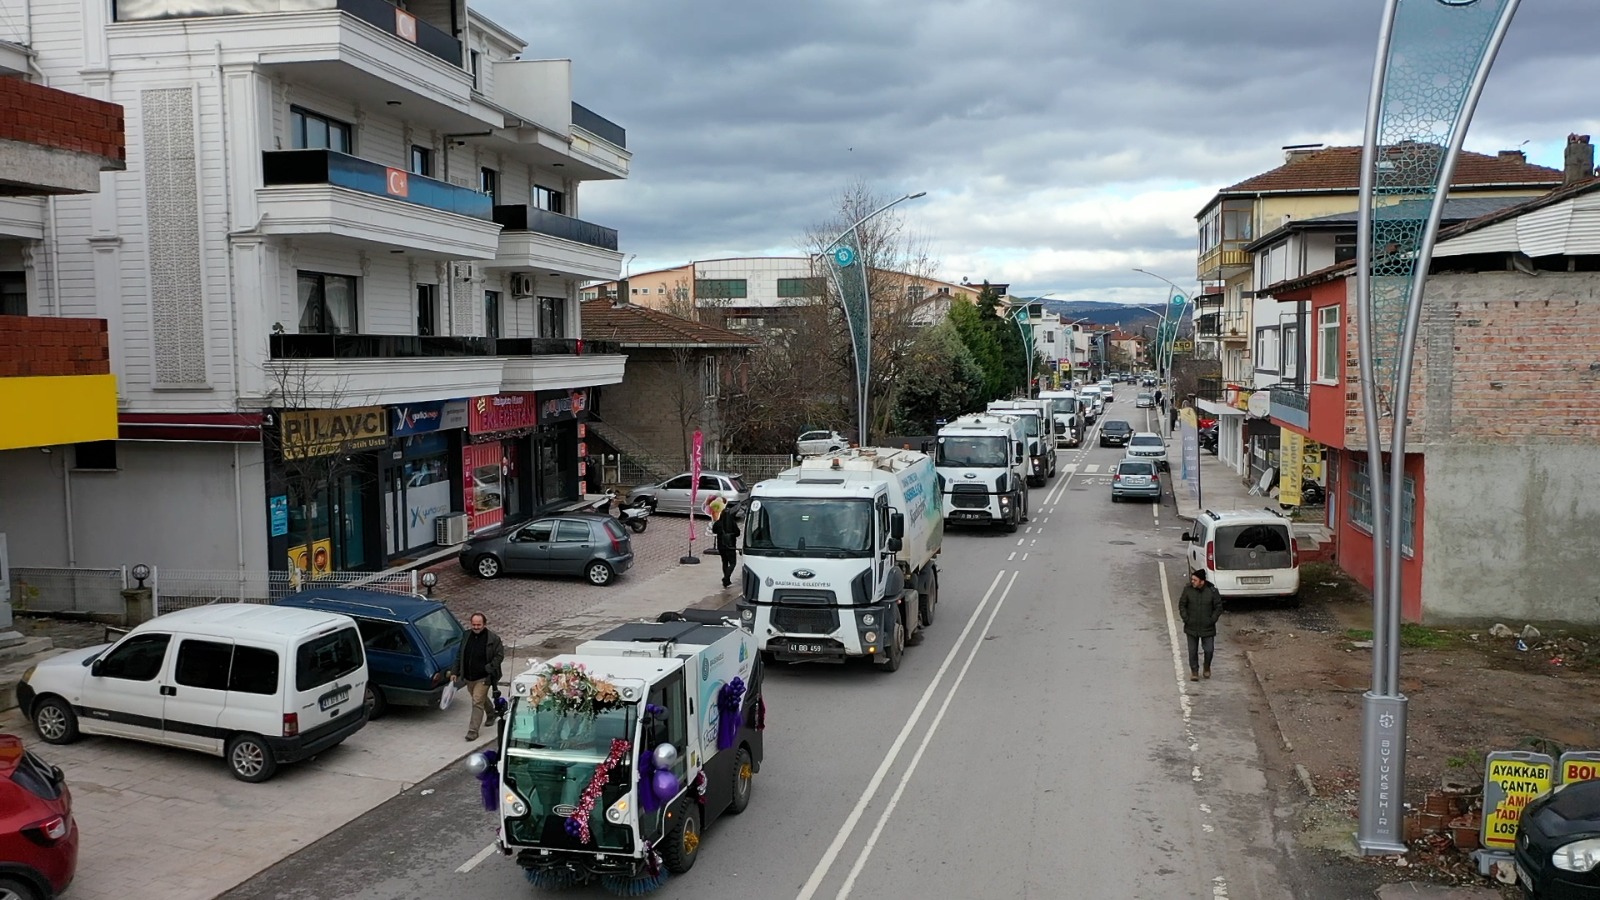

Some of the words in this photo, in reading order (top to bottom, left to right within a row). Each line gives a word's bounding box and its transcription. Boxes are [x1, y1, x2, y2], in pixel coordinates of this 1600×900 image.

[285, 412, 385, 443] PİLAVCI
[1492, 764, 1550, 780] AYAKKABI
[1378, 739, 1391, 826] BÜYÜKŞEHİR
[1501, 779, 1539, 794] ÇANTA
[1495, 808, 1520, 821] TADİ
[1493, 822, 1519, 835] LOST
